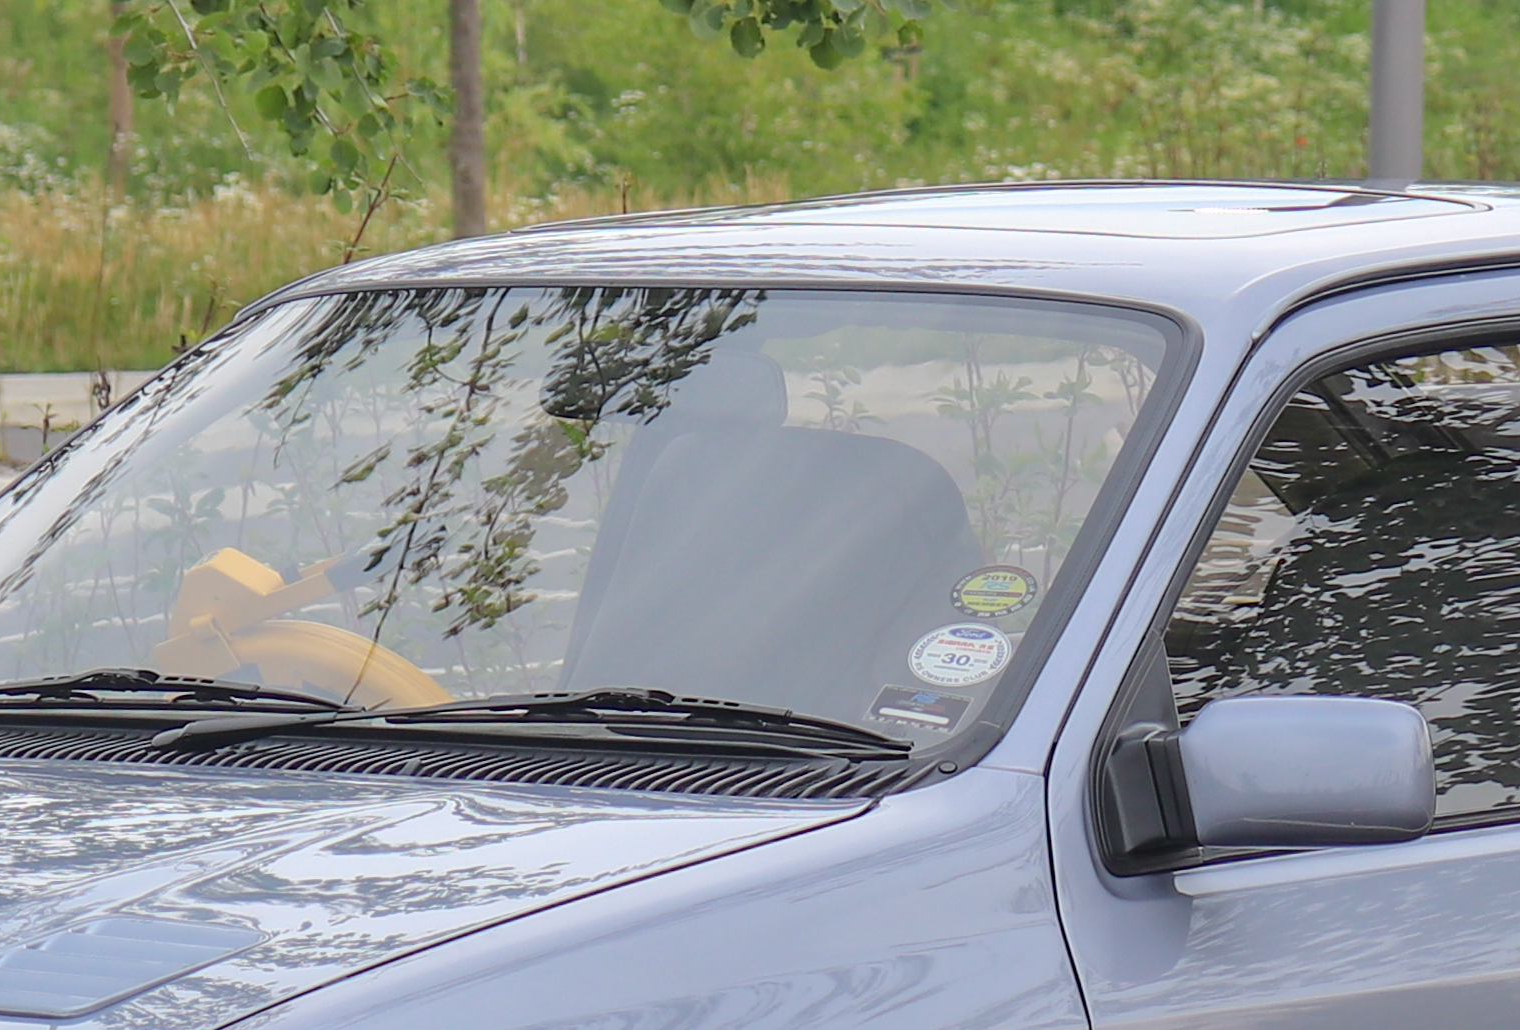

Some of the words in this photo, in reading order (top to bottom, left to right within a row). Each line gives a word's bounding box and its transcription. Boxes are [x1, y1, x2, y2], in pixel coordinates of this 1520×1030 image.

[982, 574, 1018, 583] 2019
[941, 652, 971, 666] 30
[922, 670, 960, 683] OWNERS
[963, 671, 988, 682] CLUB
